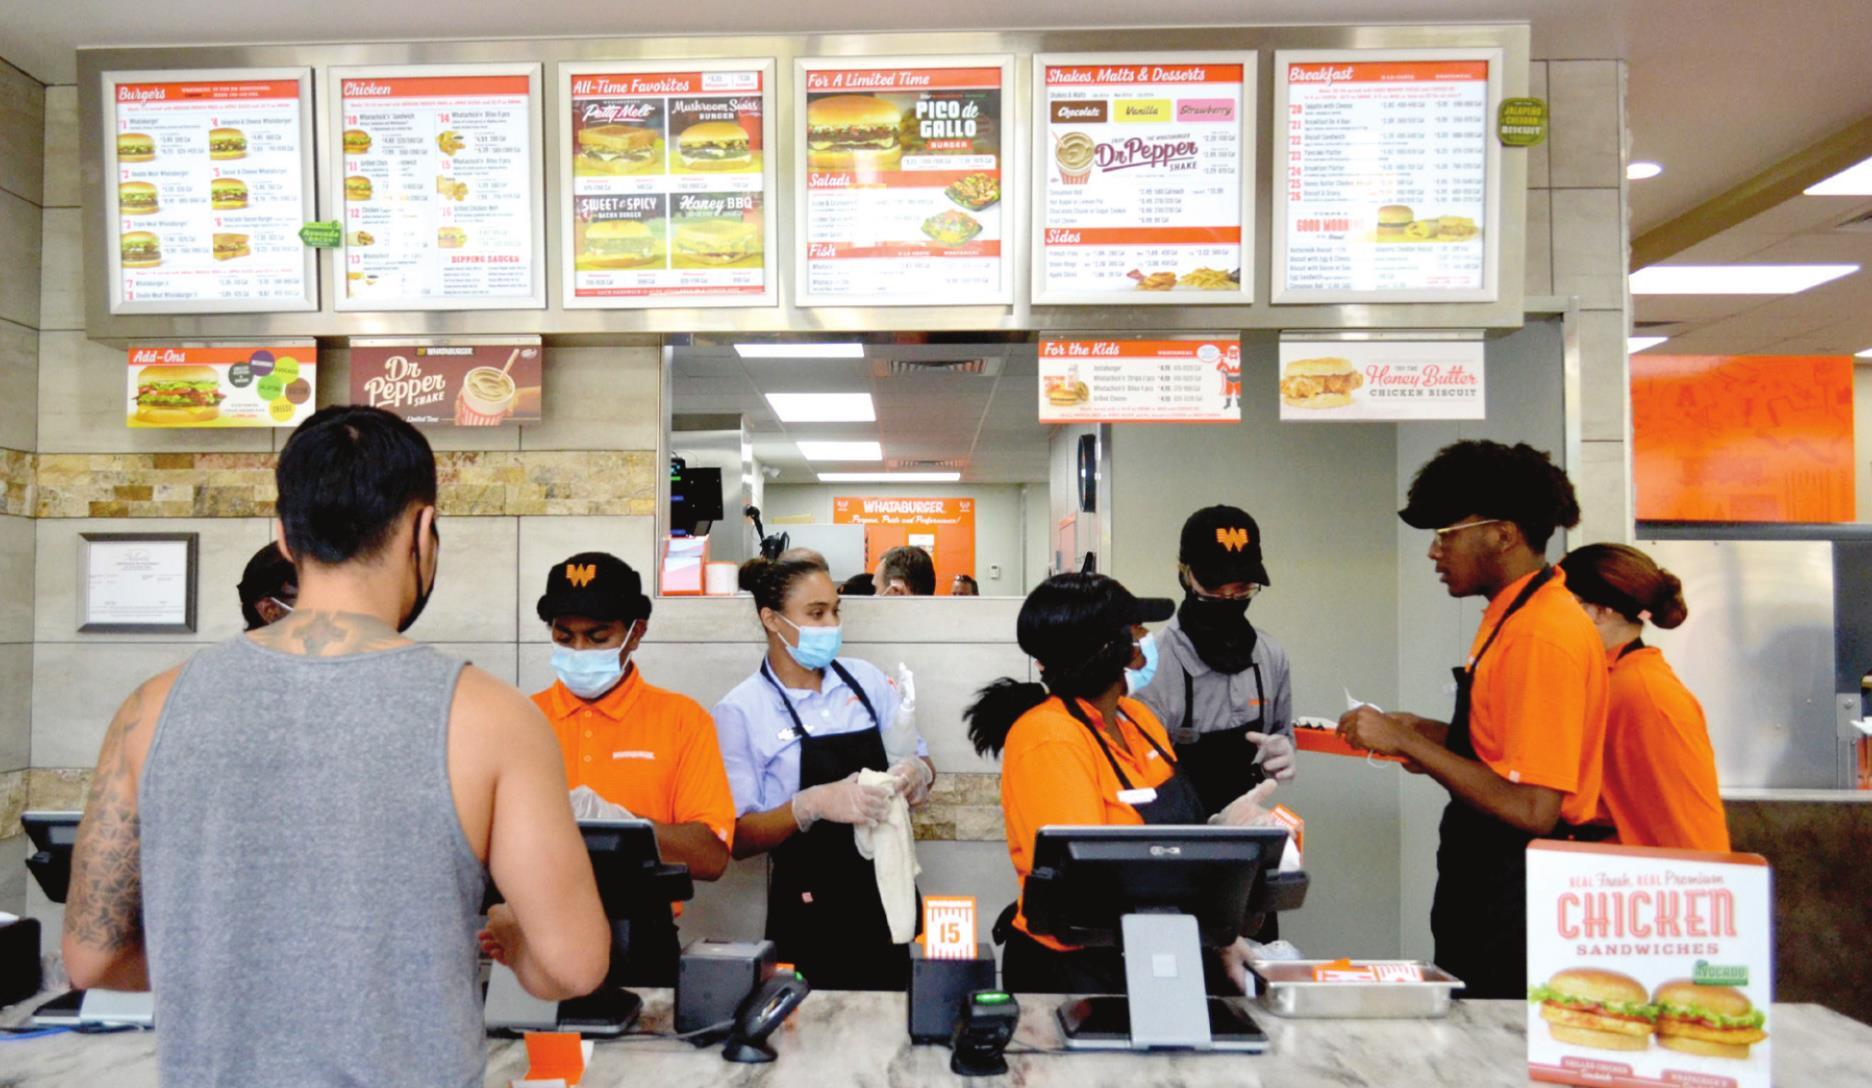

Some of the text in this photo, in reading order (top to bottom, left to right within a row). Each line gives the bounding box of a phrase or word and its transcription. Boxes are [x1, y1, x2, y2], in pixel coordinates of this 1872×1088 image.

[808, 71, 930, 88] For A Limited Time
[1097, 68, 1135, 82] Malts
[1137, 68, 1149, 81] &
[1152, 67, 1206, 82] Desserts
[1289, 66, 1354, 86] Breakfast
[344, 82, 391, 96] Chicken
[573, 79, 627, 94] All-Time
[631, 78, 690, 93] Favorites
[119, 86, 165, 106] Burgers
[672, 98, 760, 114] Mushroom Swiss
[916, 100, 980, 119] PICO de
[1058, 106, 1100, 118] Chocolate
[1126, 106, 1159, 116] Vanilla
[1180, 104, 1232, 117] Strawberry
[582, 104, 656, 124] Patty Melt
[920, 120, 977, 138] GALLO
[1094, 142, 1127, 167] Dr
[1124, 136, 1198, 168] Pepper
[1169, 162, 1198, 172] SHAKE
[808, 173, 850, 188] Salads
[582, 198, 618, 212] SWEET
[627, 197, 656, 210] SPICY
[680, 195, 752, 214] Honey BBQ
[1297, 218, 1320, 232] GOOD
[1046, 229, 1081, 244] Sides
[809, 242, 836, 257] Fish
[133, 350, 186, 363] Add-Ons
[1044, 342, 1120, 356] For the Kids
[384, 356, 422, 382] Dr
[1366, 364, 1478, 388] Honey Butter
[364, 373, 446, 408] Pepper
[1370, 389, 1477, 397] CHICKEN BISCUIT
[864, 500, 944, 514] WHATABURGER
[1570, 876, 1593, 888] REAL
[1636, 872, 1662, 886] REAL
[1664, 870, 1724, 886] Premium
[1557, 888, 1737, 940] CHICKEN
[940, 922, 961, 944] 15
[1576, 942, 1720, 957] SANDWICHES
